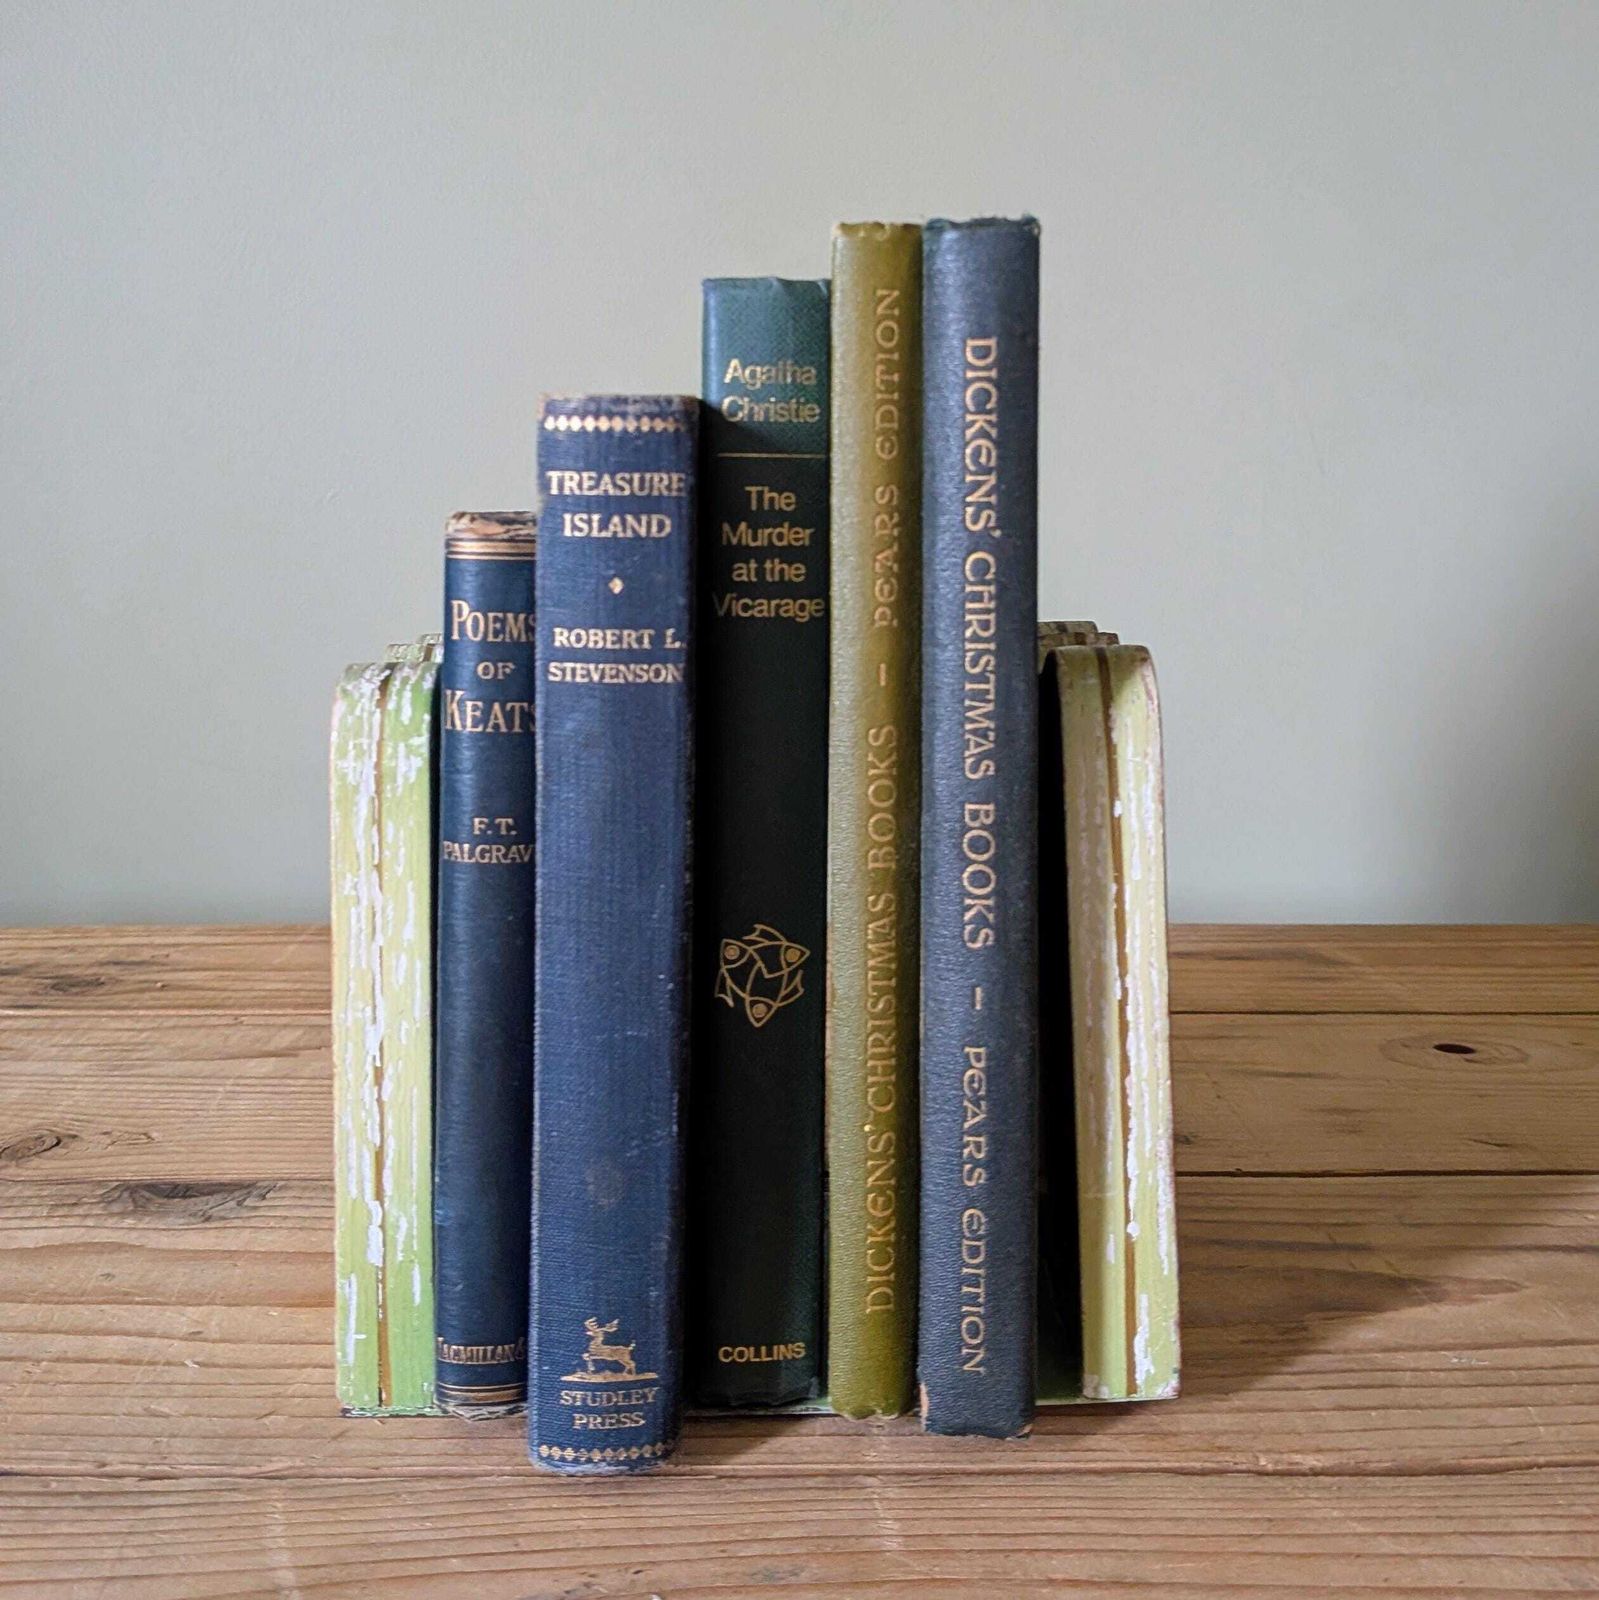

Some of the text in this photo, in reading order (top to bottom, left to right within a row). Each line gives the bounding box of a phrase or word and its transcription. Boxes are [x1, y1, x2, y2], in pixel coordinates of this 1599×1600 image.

[723, 358, 818, 390] Agatha
[721, 395, 821, 422] Christie
[546, 470, 687, 497] TREASURE
[745, 485, 796, 512] The
[563, 513, 672, 538] ISLAND
[722, 521, 815, 547] Murder
[732, 557, 807, 582] at the
[714, 592, 826, 623] Vicarage
[553, 627, 687, 650] ROBERT L.
[476, 661, 516, 680] OF
[548, 662, 686, 684] STEVENSON
[963, 550, 997, 781] CHRISTMAS
[867, 724, 898, 871] BOOKS
[443, 840, 535, 863] PALGRAV
[961, 801, 997, 950] BOOKS
[866, 892, 897, 1113] CHRISTMAS
[718, 1342, 807, 1364] COLLINS
[560, 1386, 661, 1407] STUDLEY
[573, 1412, 647, 1431] PRESS
